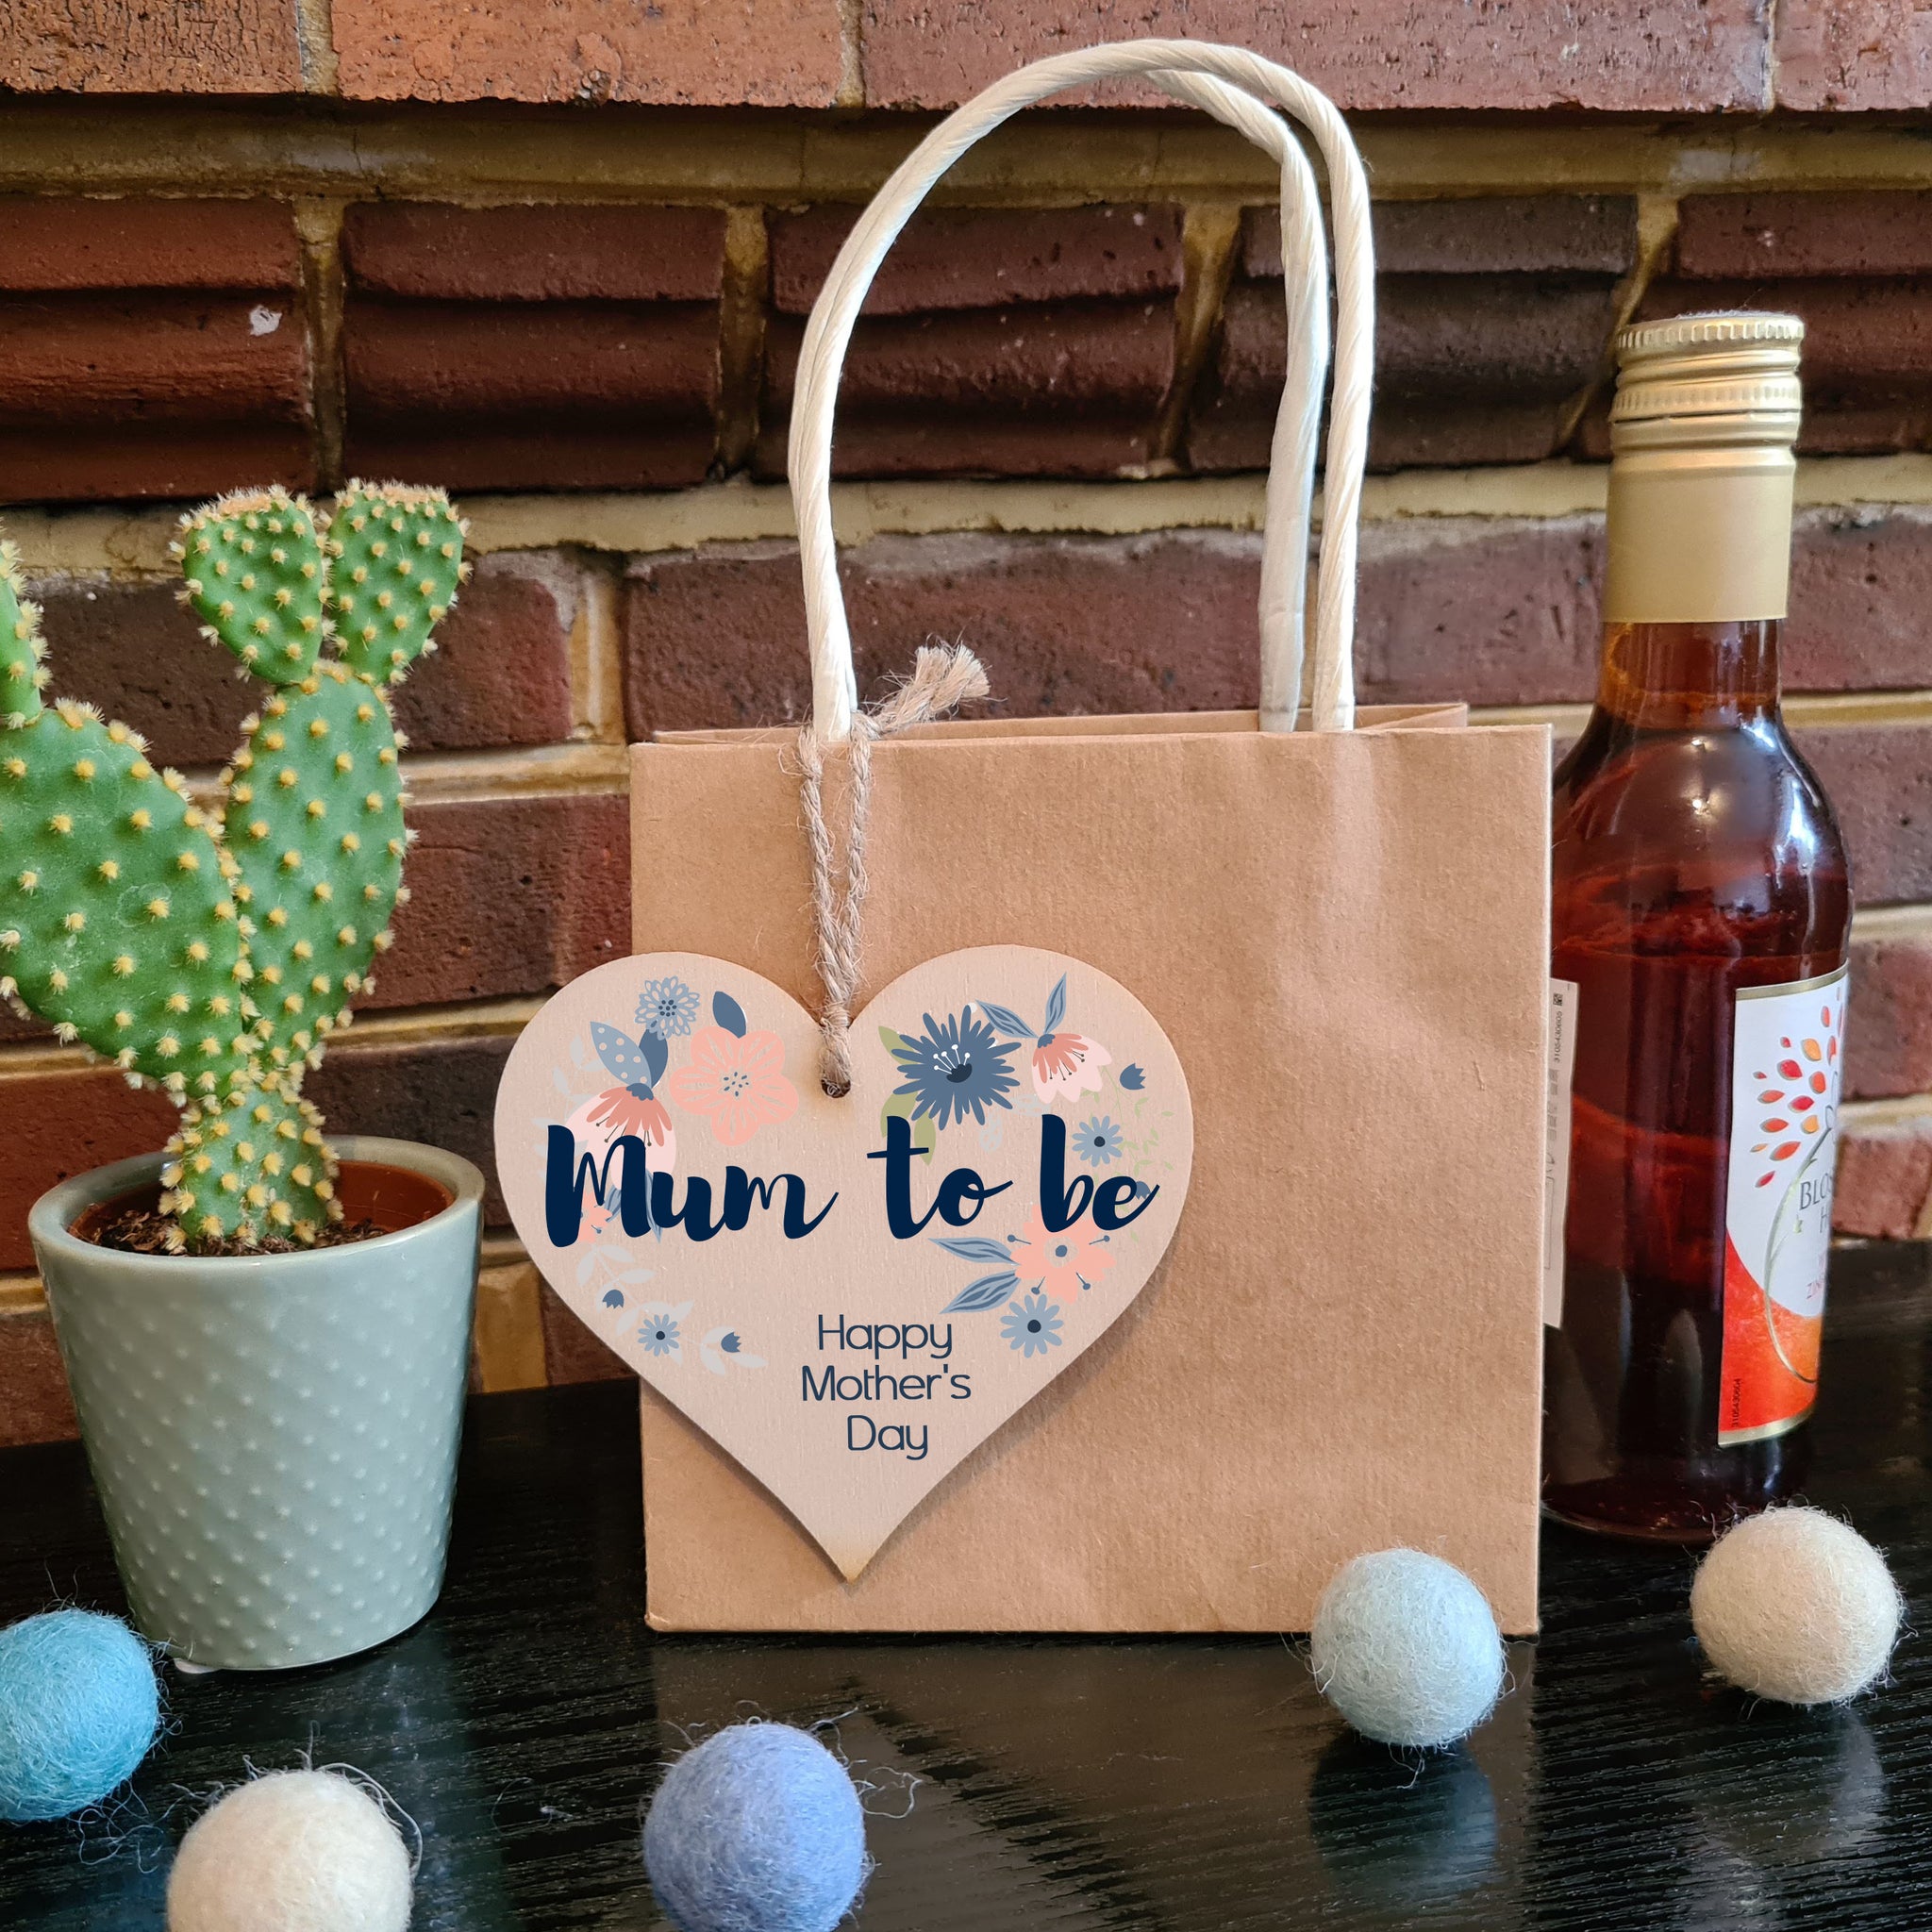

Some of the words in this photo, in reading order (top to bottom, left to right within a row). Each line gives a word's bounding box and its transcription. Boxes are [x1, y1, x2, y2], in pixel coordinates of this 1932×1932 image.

[545, 1124, 840, 1248] Mum
[866, 1115, 1014, 1240] to
[1040, 1113, 1160, 1233] be
[818, 1314, 953, 1360] Happy
[802, 1363, 972, 1401] Mother's
[847, 1414, 928, 1460] Day
